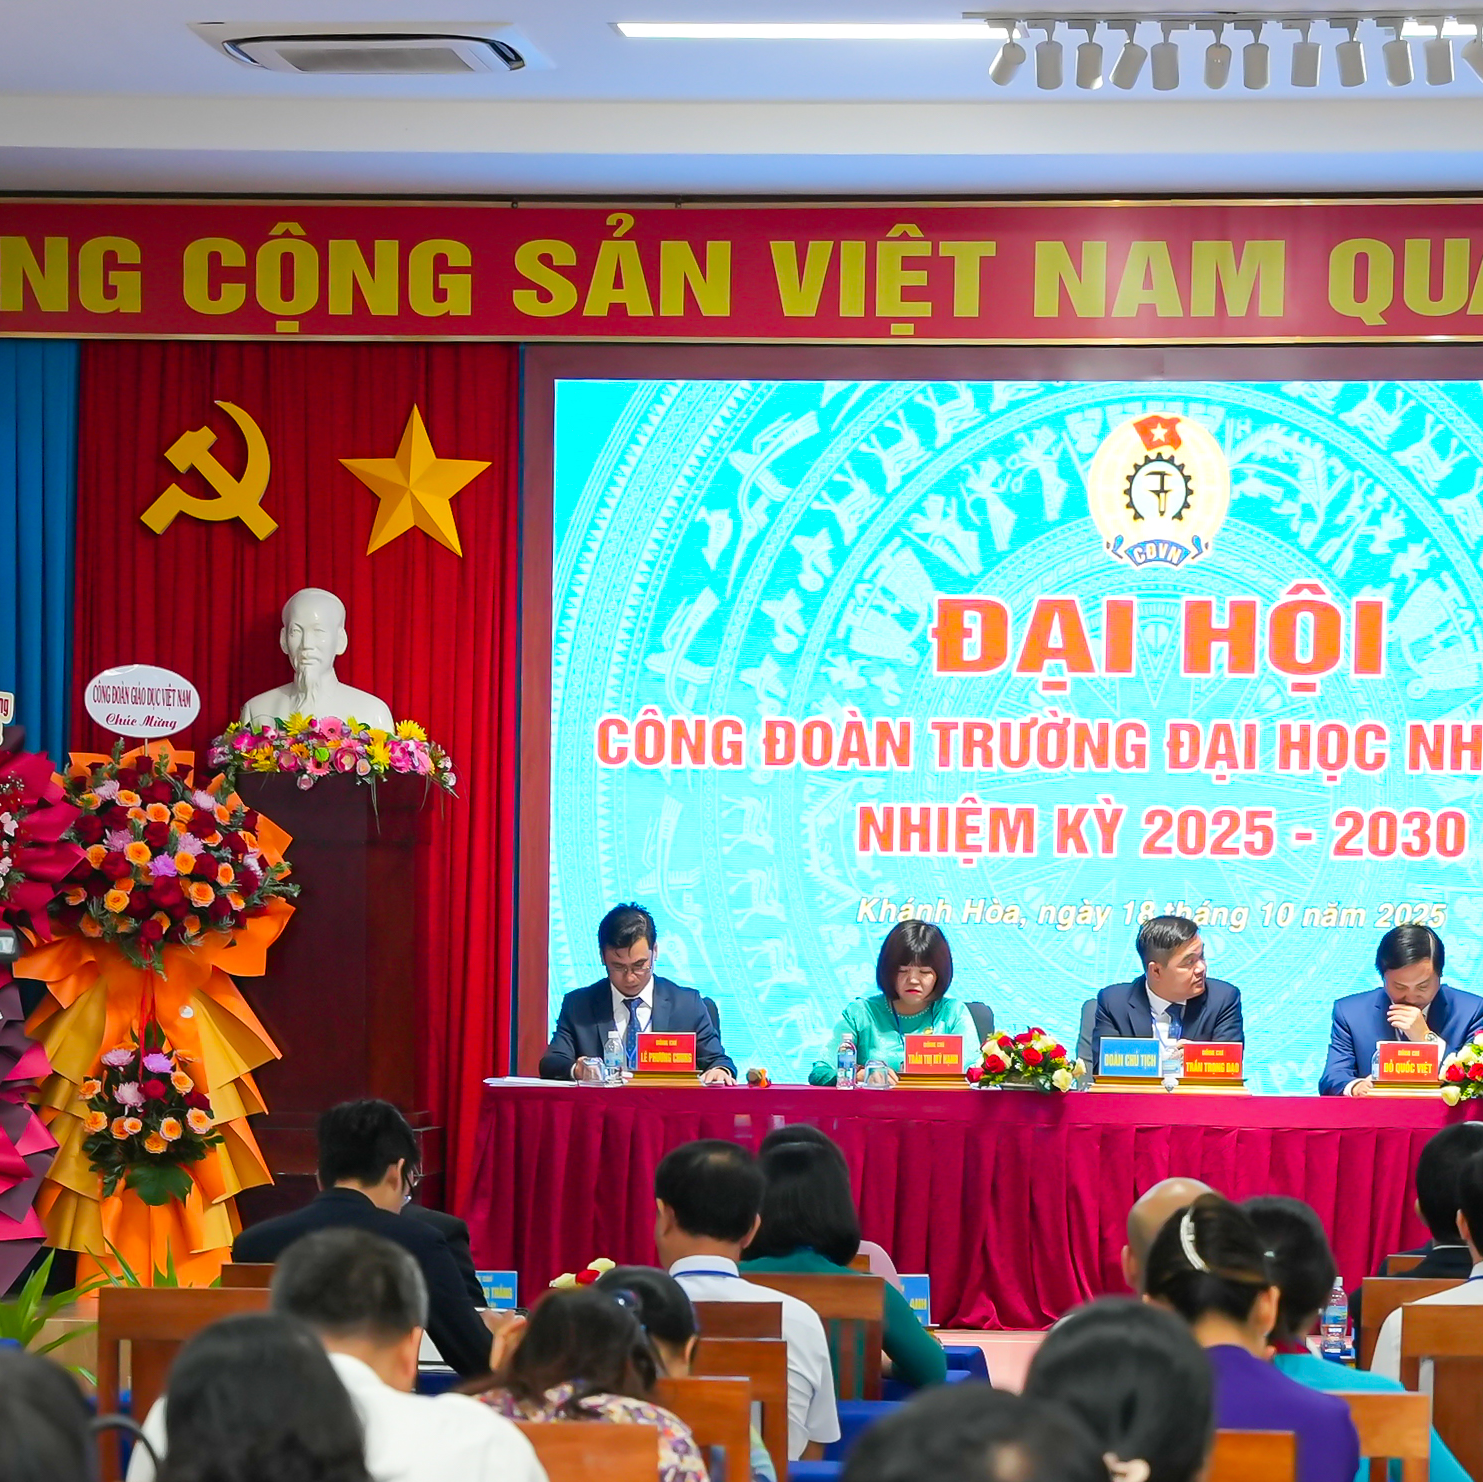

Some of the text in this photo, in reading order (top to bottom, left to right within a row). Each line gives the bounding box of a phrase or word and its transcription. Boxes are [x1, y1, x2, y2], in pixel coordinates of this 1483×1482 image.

[183, 222, 472, 333] CỘNG
[512, 212, 731, 318] SẢN
[769, 223, 997, 335] VIỆT
[1033, 240, 1285, 319] NAM
[930, 583, 1383, 693] ĐẠI HỘI
[106, 713, 178, 730] Chúc Mừng
[596, 708, 745, 767] CÔNG
[762, 709, 912, 768] ĐOÀN
[930, 710, 1148, 768] TRƯỜNG
[1167, 724, 1257, 782] ĐẠI
[1278, 724, 1387, 782] HỌC
[858, 797, 1035, 865] NHIỆM
[1055, 797, 1126, 855] KỲ
[1142, 810, 1276, 857] 2025
[1333, 810, 1468, 857] 2030
[856, 897, 1448, 933] Khánh Hòa, ngày 18 tháng 10 năm 2025
